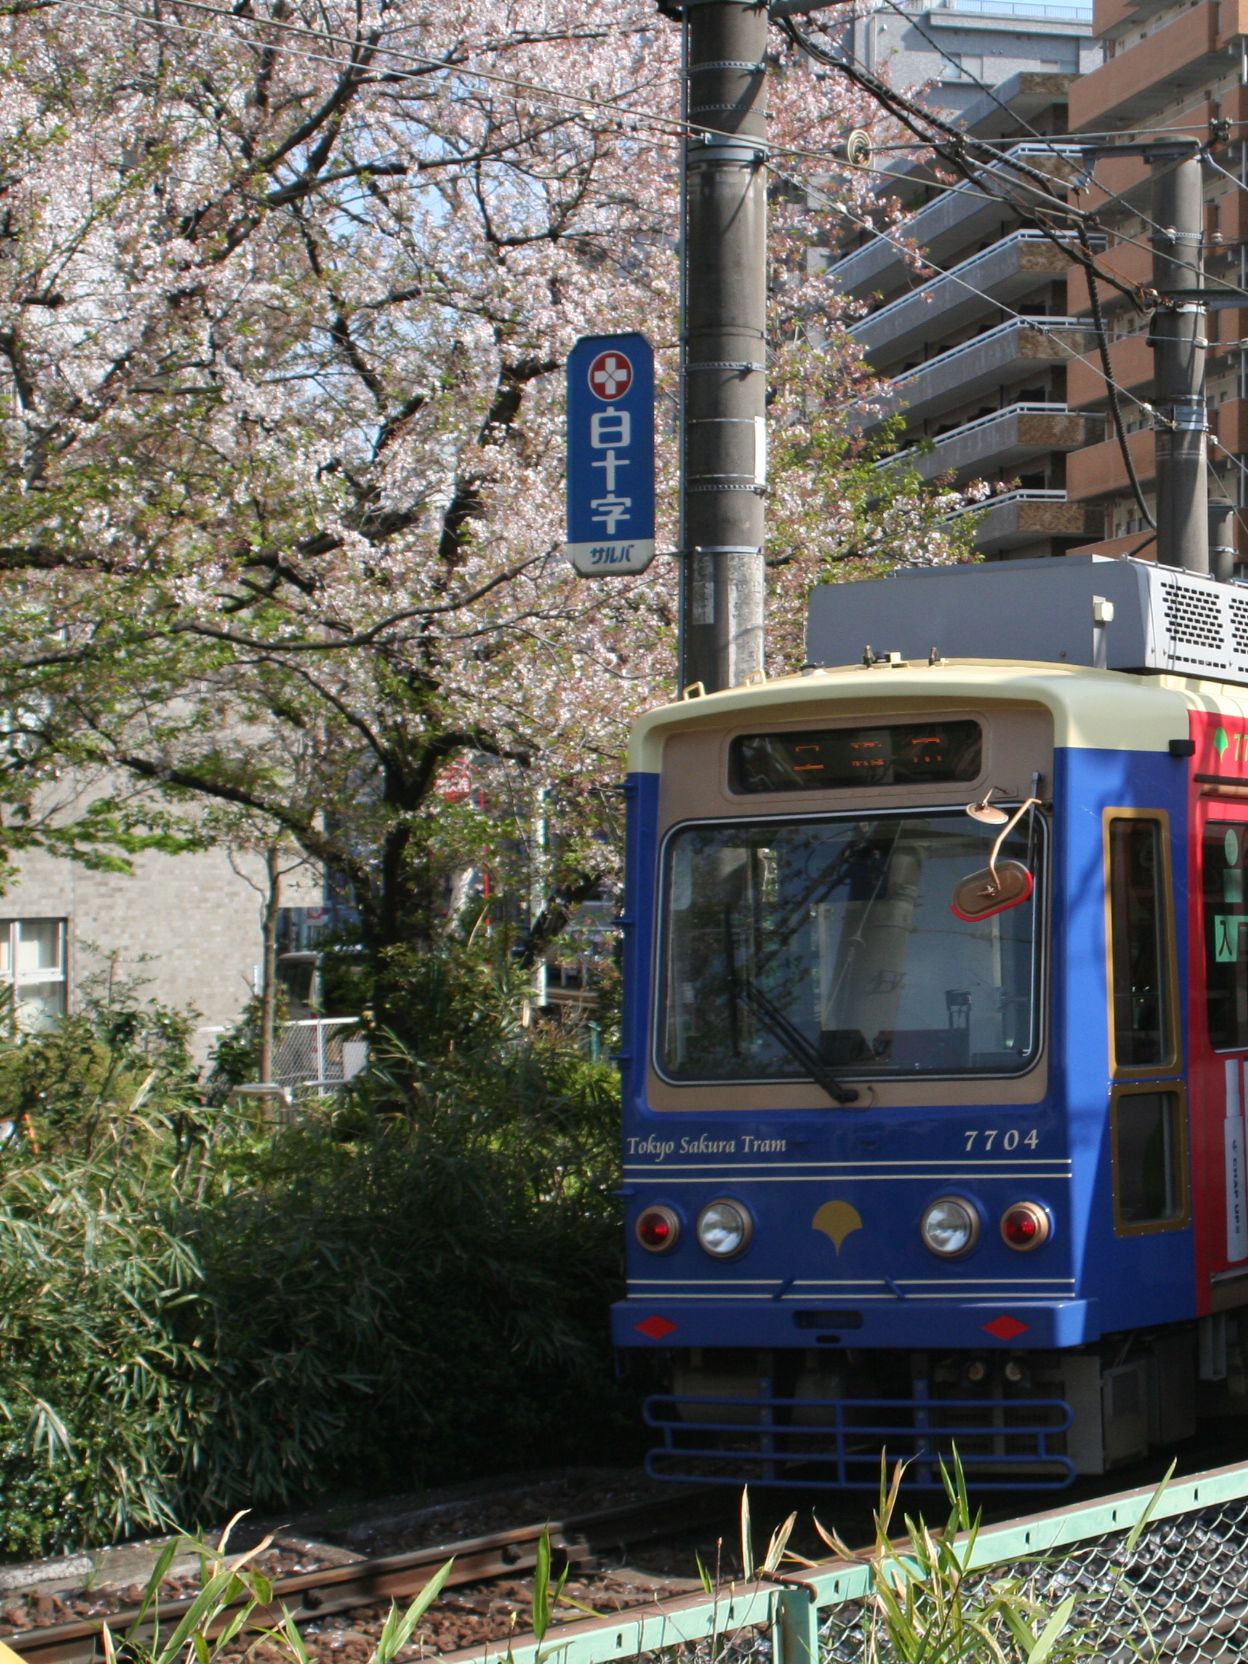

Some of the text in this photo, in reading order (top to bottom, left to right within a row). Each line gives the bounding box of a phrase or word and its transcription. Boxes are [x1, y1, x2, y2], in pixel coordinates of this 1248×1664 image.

[590, 406, 632, 535] 白十字
[590, 544, 635, 565] サルバ
[626, 1132, 787, 1162] Tokyo Sakura Tram
[964, 1128, 1040, 1152] 7704
